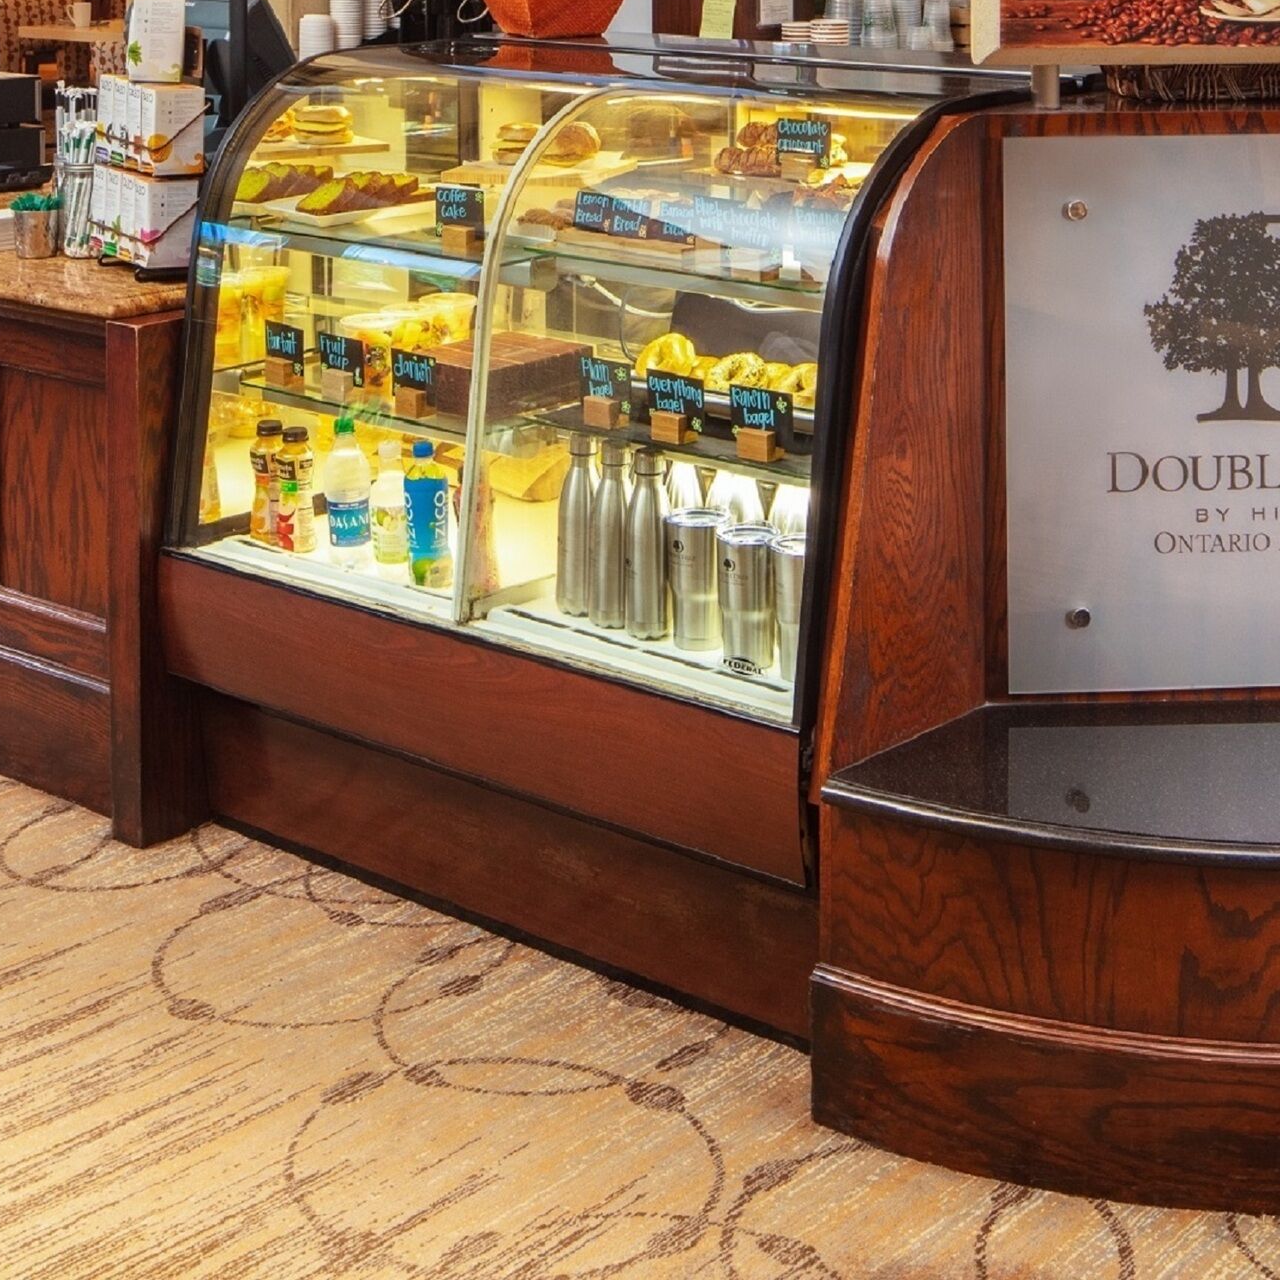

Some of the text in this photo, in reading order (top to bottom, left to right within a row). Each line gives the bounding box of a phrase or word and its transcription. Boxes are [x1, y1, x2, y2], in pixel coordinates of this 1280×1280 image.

[778, 118, 829, 136] Chocolate
[577, 192, 610, 207] Lemon
[575, 209, 603, 222] Bread
[613, 216, 642, 231] Bread
[267, 324, 297, 355] Parfait
[320, 335, 346, 356] Fruit
[394, 354, 433, 384] danish
[581, 357, 610, 381] Plain
[589, 381, 613, 397] bagel
[649, 375, 703, 408] everything
[731, 386, 771, 409] Raisin
[656, 394, 685, 413] bagel
[743, 409, 775, 430] bagel
[330, 513, 369, 530] DASANI
[1194, 507, 1230, 523] BY
[1153, 531, 1271, 554] ONTARIO
[723, 658, 762, 674] FEDERAL
